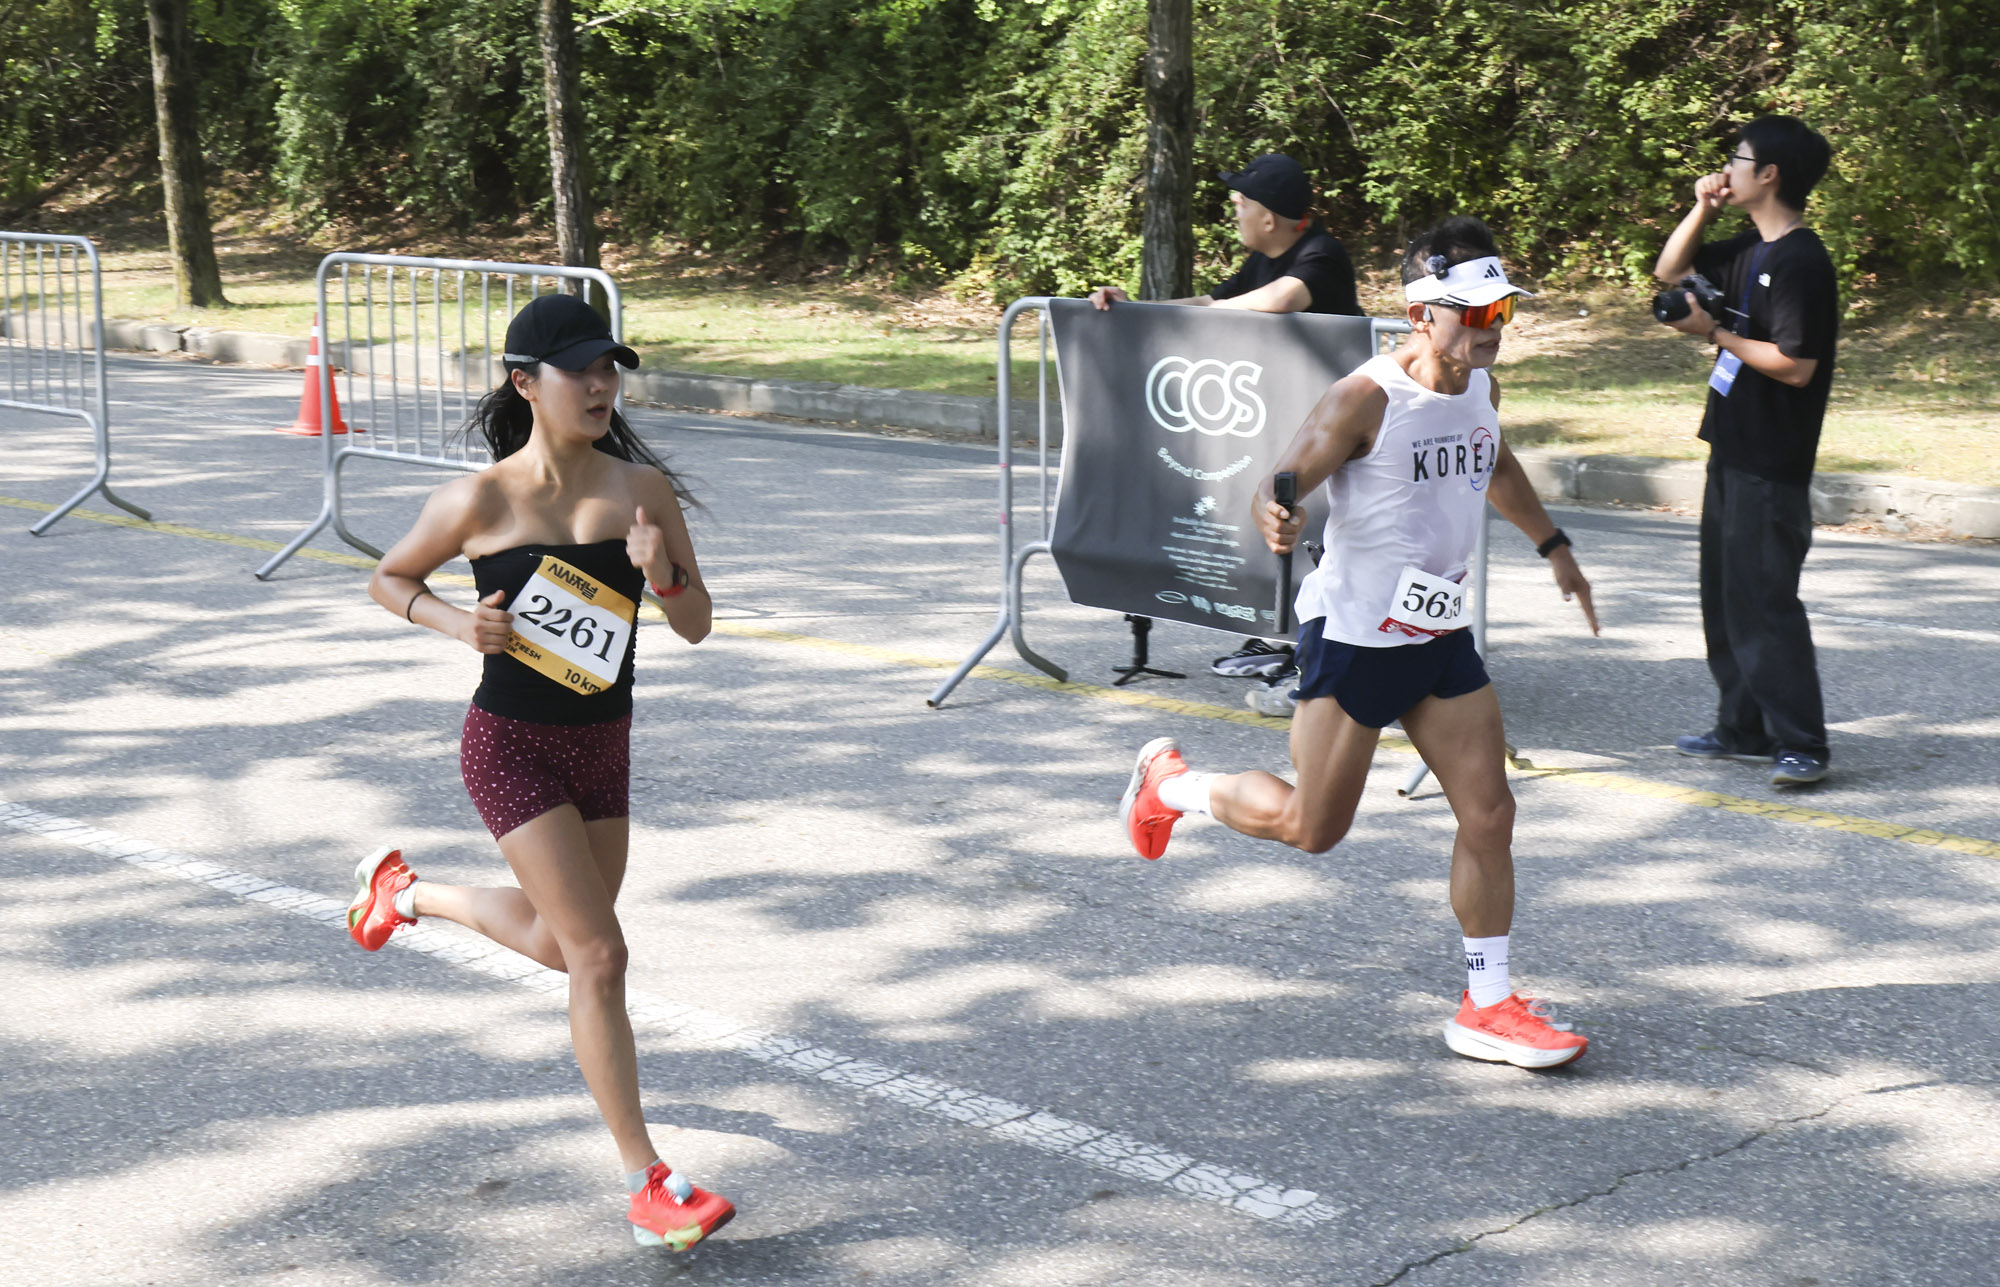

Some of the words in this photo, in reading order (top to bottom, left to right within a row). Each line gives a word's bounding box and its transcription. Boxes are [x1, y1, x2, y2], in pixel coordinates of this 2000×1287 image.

[548, 563, 599, 601] 시사저널
[518, 594, 616, 663] 2261
[564, 668, 581, 685] 10
[580, 677, 602, 694] km
